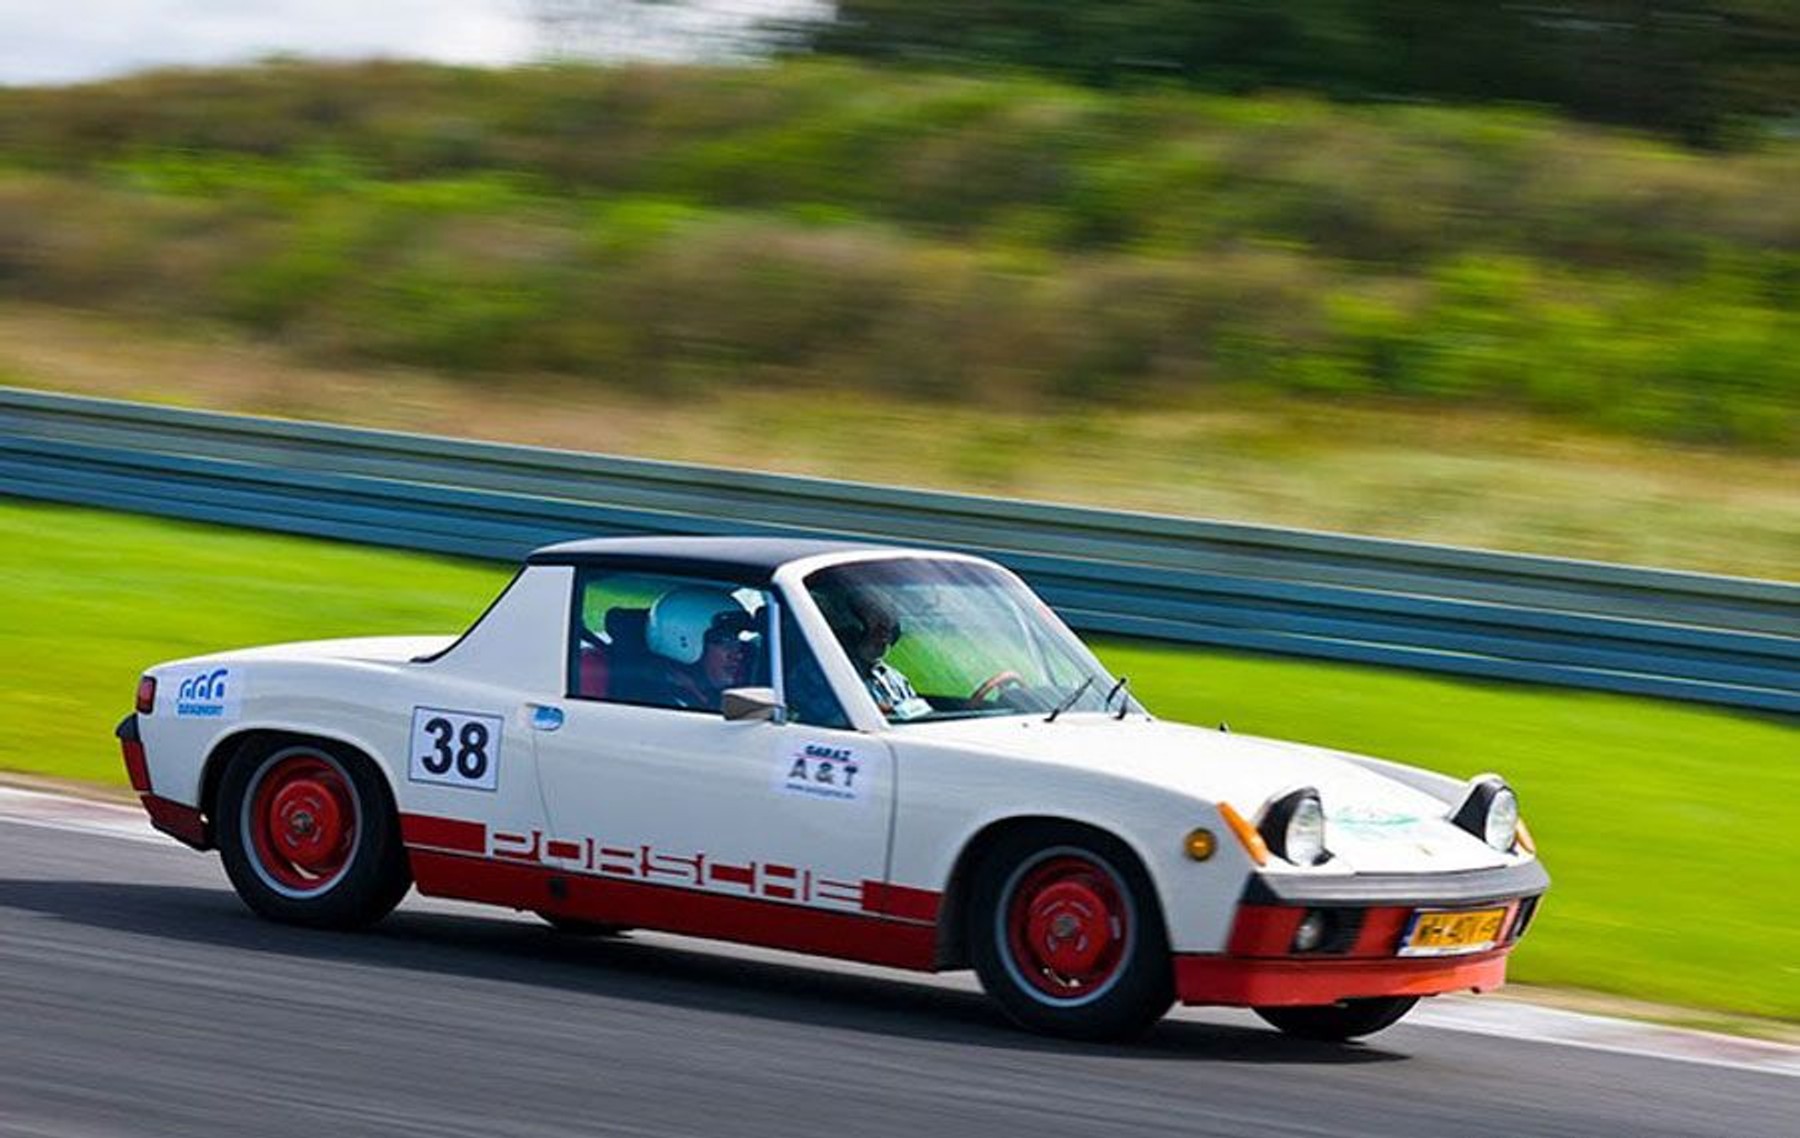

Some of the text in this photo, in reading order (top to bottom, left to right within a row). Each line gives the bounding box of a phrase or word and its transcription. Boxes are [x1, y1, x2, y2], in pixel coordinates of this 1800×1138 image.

[421, 717, 490, 780] 38
[788, 758, 858, 787] A & T
[484, 823, 863, 912] PORSCHE
